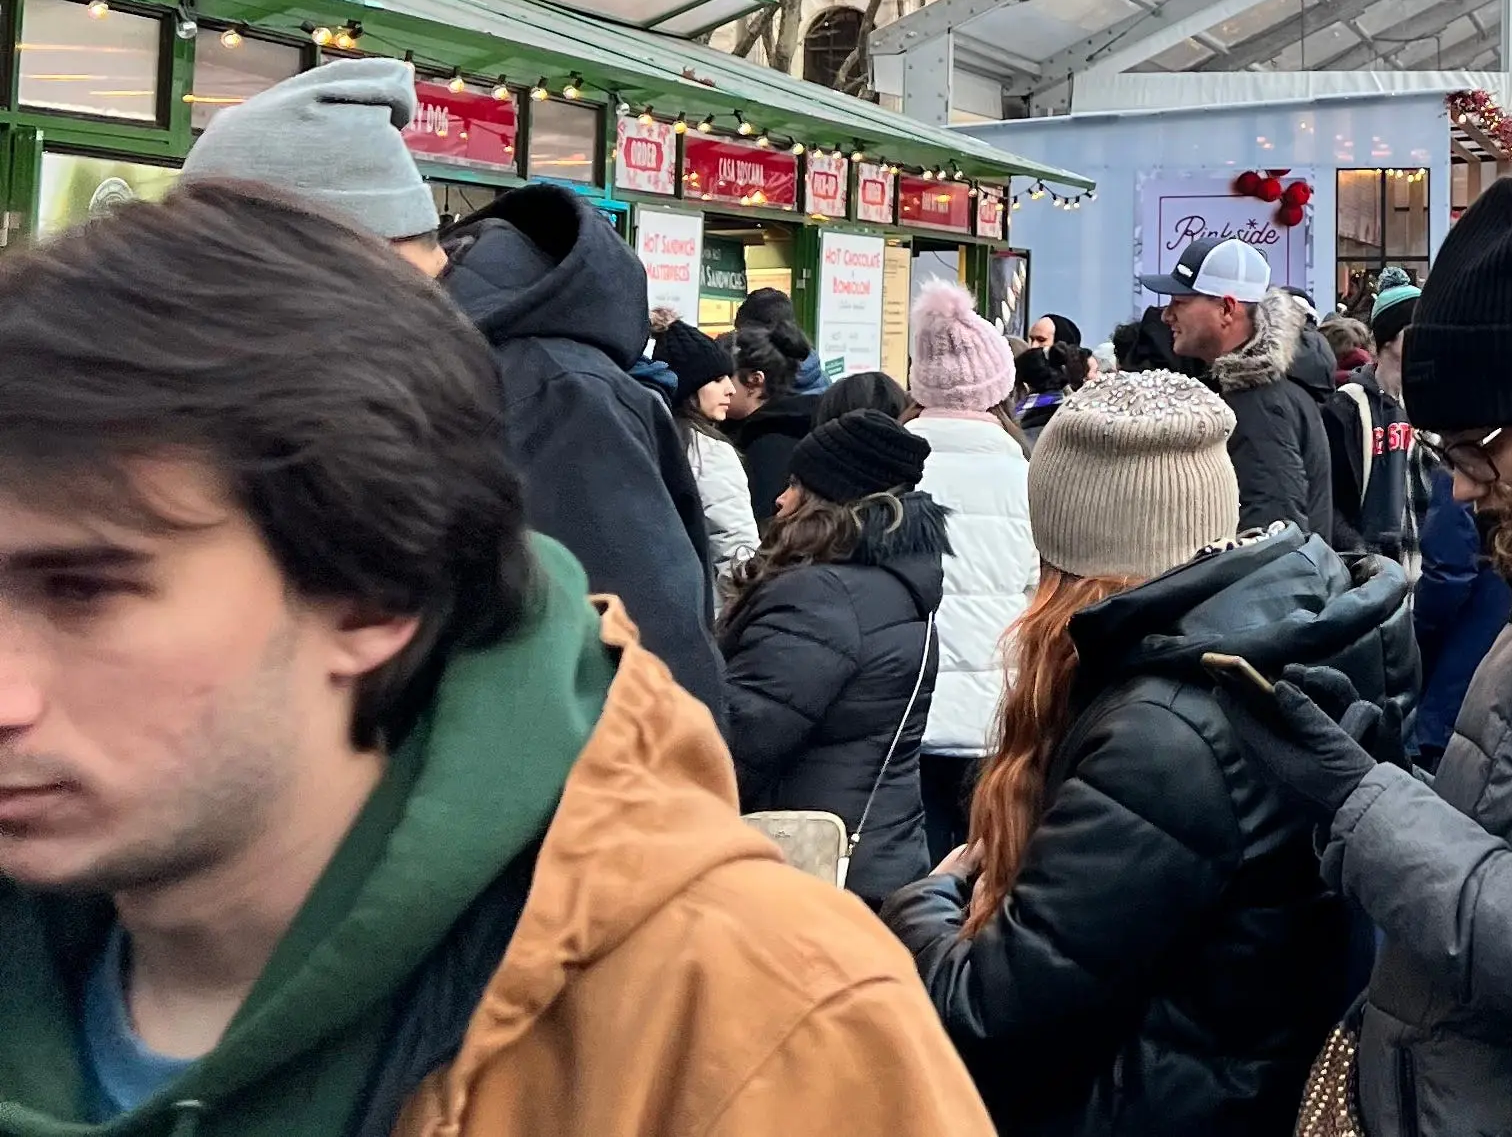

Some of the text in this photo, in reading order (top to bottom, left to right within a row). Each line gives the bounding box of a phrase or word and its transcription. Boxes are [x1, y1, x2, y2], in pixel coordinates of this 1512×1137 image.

[718, 157, 765, 186] CASA TOSCANA
[825, 249, 842, 265] HOT
